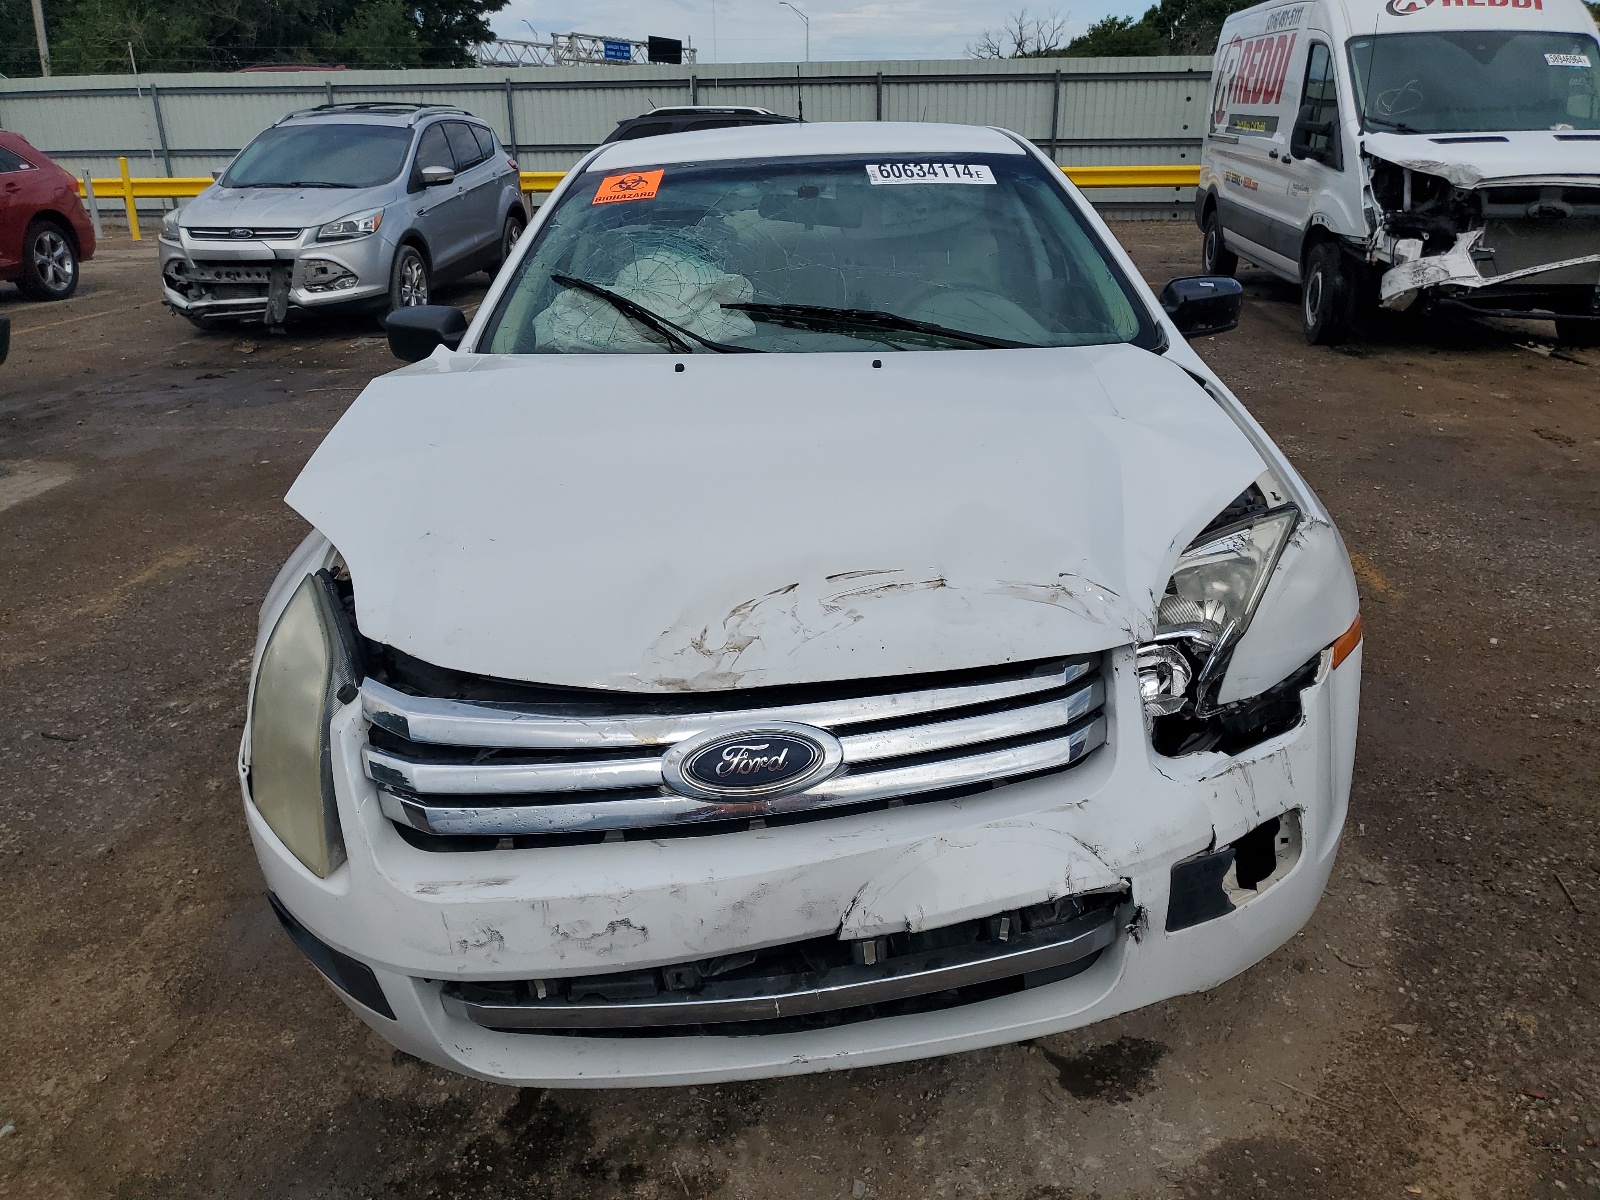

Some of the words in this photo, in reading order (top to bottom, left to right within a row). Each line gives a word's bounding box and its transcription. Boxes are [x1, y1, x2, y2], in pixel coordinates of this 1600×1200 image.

[1233, 32, 1298, 104] REDDI
[878, 163, 974, 179] 60634114
[975, 170, 984, 179] E
[595, 191, 655, 203] BIOHAZARD
[715, 743, 790, 778] Ford
